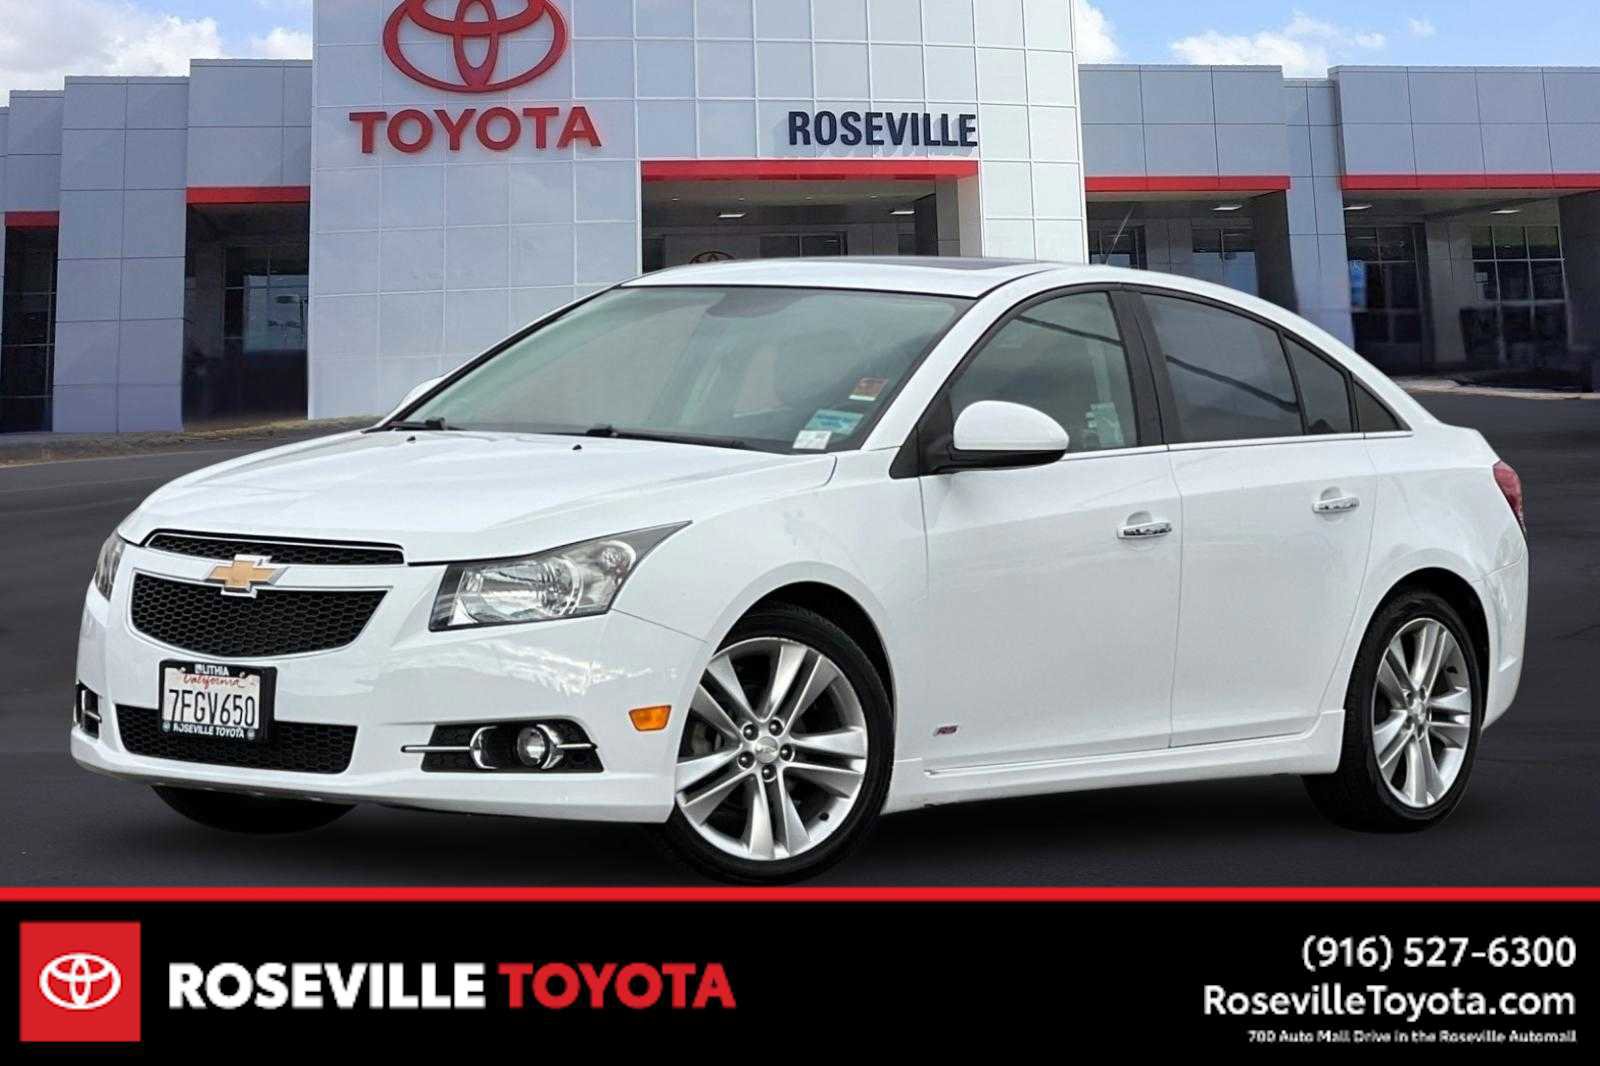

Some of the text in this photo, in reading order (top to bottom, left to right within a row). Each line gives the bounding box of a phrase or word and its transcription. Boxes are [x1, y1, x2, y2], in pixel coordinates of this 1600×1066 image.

[349, 106, 602, 154] TOYOTA
[788, 111, 978, 147] ROSEVILLE
[169, 689, 255, 727] 7FGV650
[215, 726, 245, 739] TOYOTA
